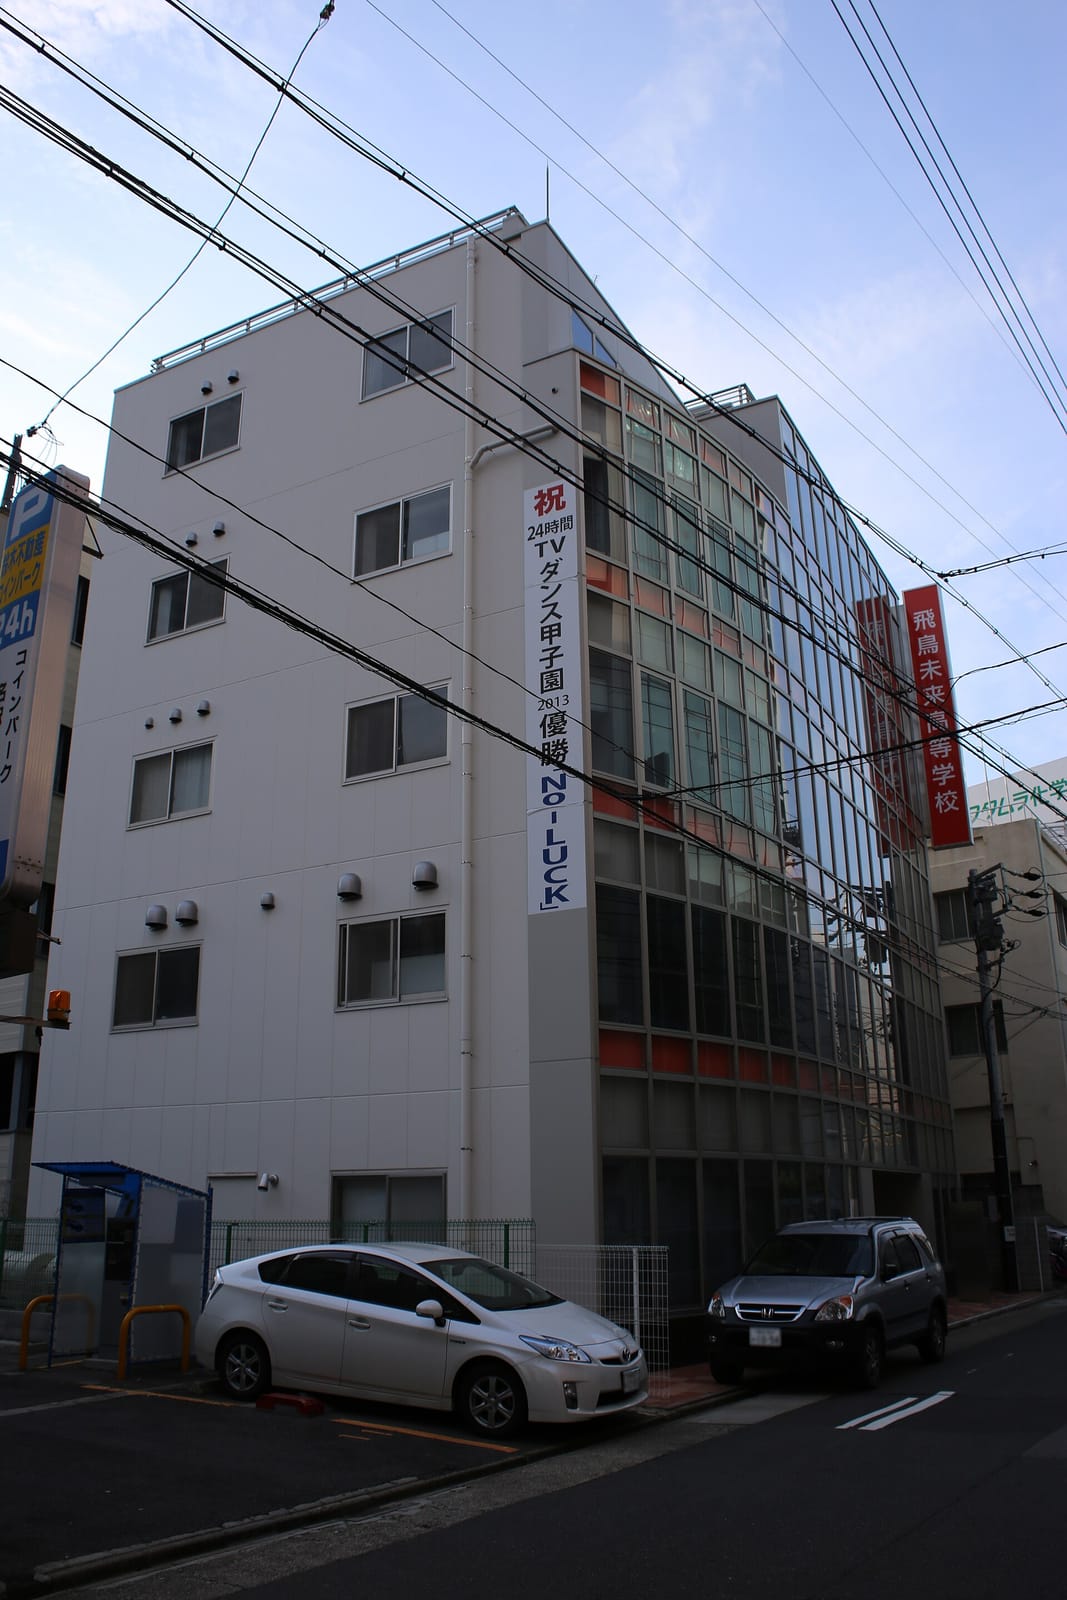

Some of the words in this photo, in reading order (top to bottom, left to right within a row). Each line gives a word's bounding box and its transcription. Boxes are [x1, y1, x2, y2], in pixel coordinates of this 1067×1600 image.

[10, 485, 49, 541] P
[534, 484, 566, 517] 祝
[527, 515, 574, 541] 24時間
[534, 536, 566, 558] TV
[539, 557, 565, 694] ダンス甲子園
[0, 649, 28, 784] コインパーク
[537, 695, 570, 712] 2013
[913, 608, 960, 814] 飛鳥未来高等学校
